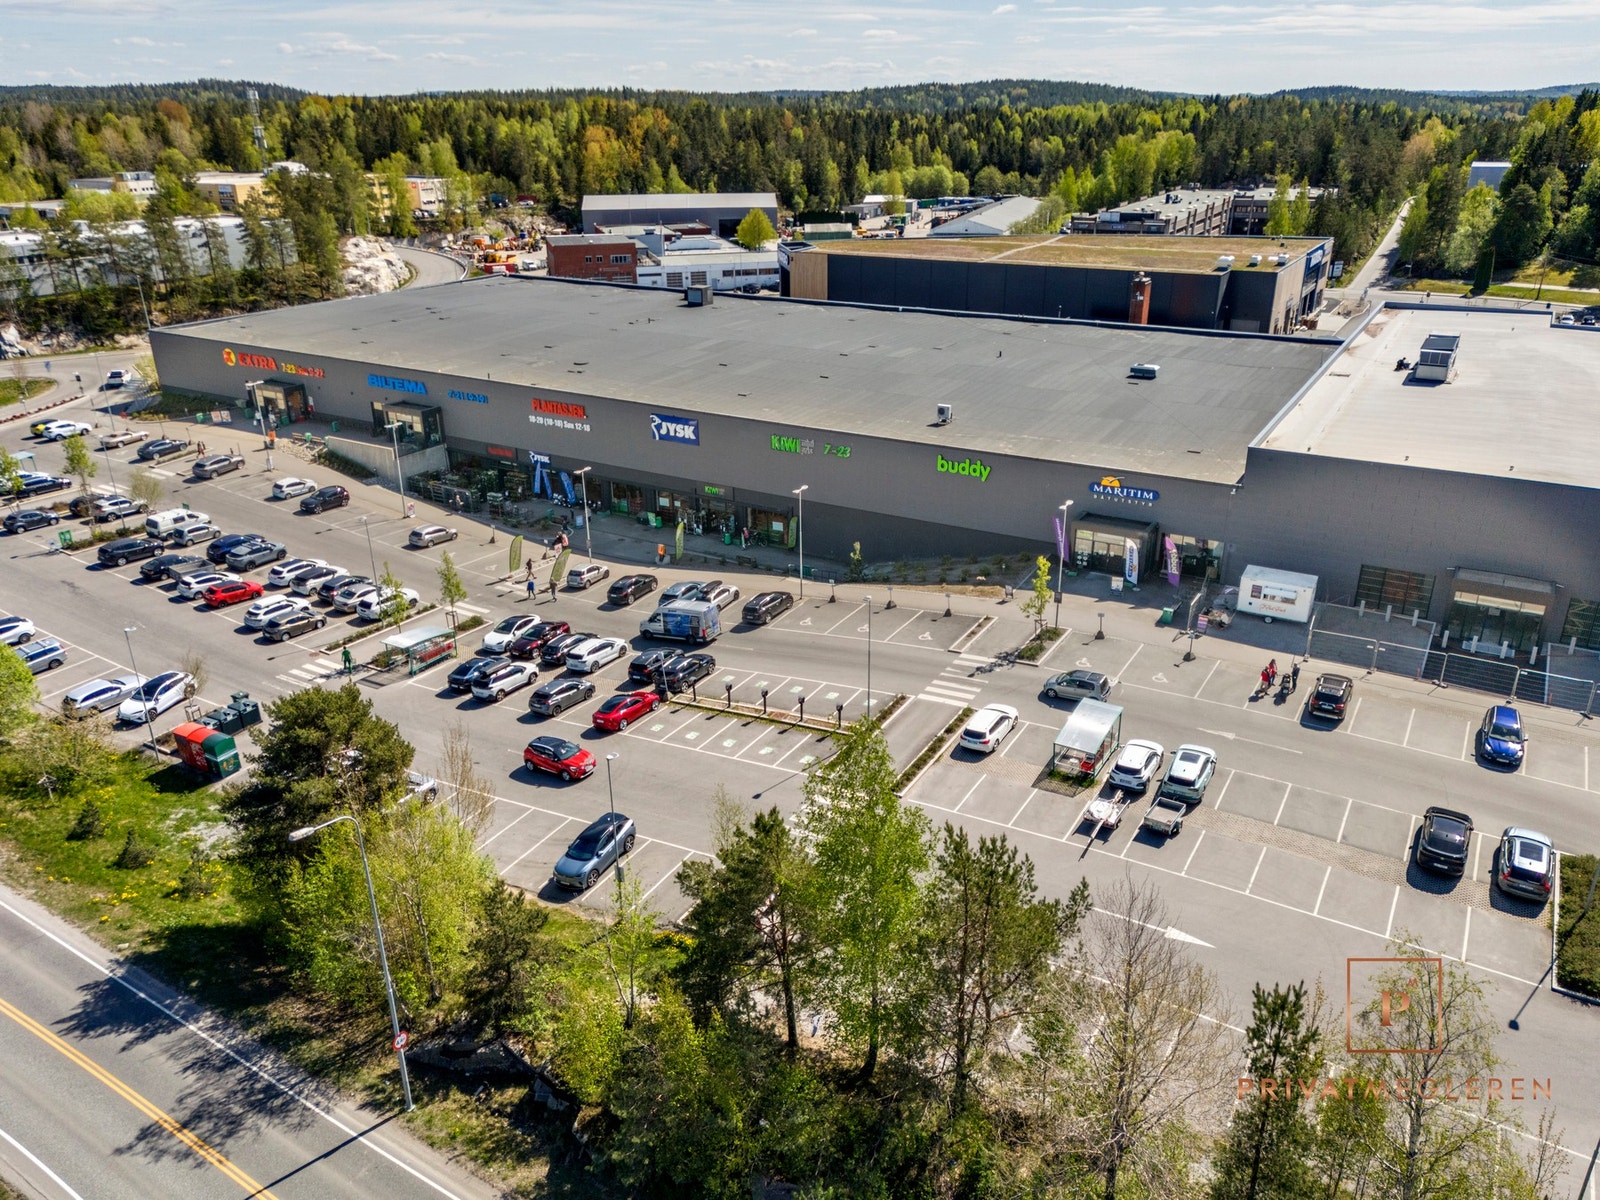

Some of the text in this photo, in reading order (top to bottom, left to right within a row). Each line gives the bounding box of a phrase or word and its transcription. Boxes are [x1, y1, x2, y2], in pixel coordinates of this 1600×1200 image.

[238, 353, 279, 371] EXTRA
[367, 374, 428, 395] BILTEMA
[660, 421, 697, 440] JYSK
[771, 434, 799, 453] KIWI
[823, 443, 851, 458] 7-23
[937, 454, 991, 482] buddy
[1093, 484, 1154, 500] MARITIM
